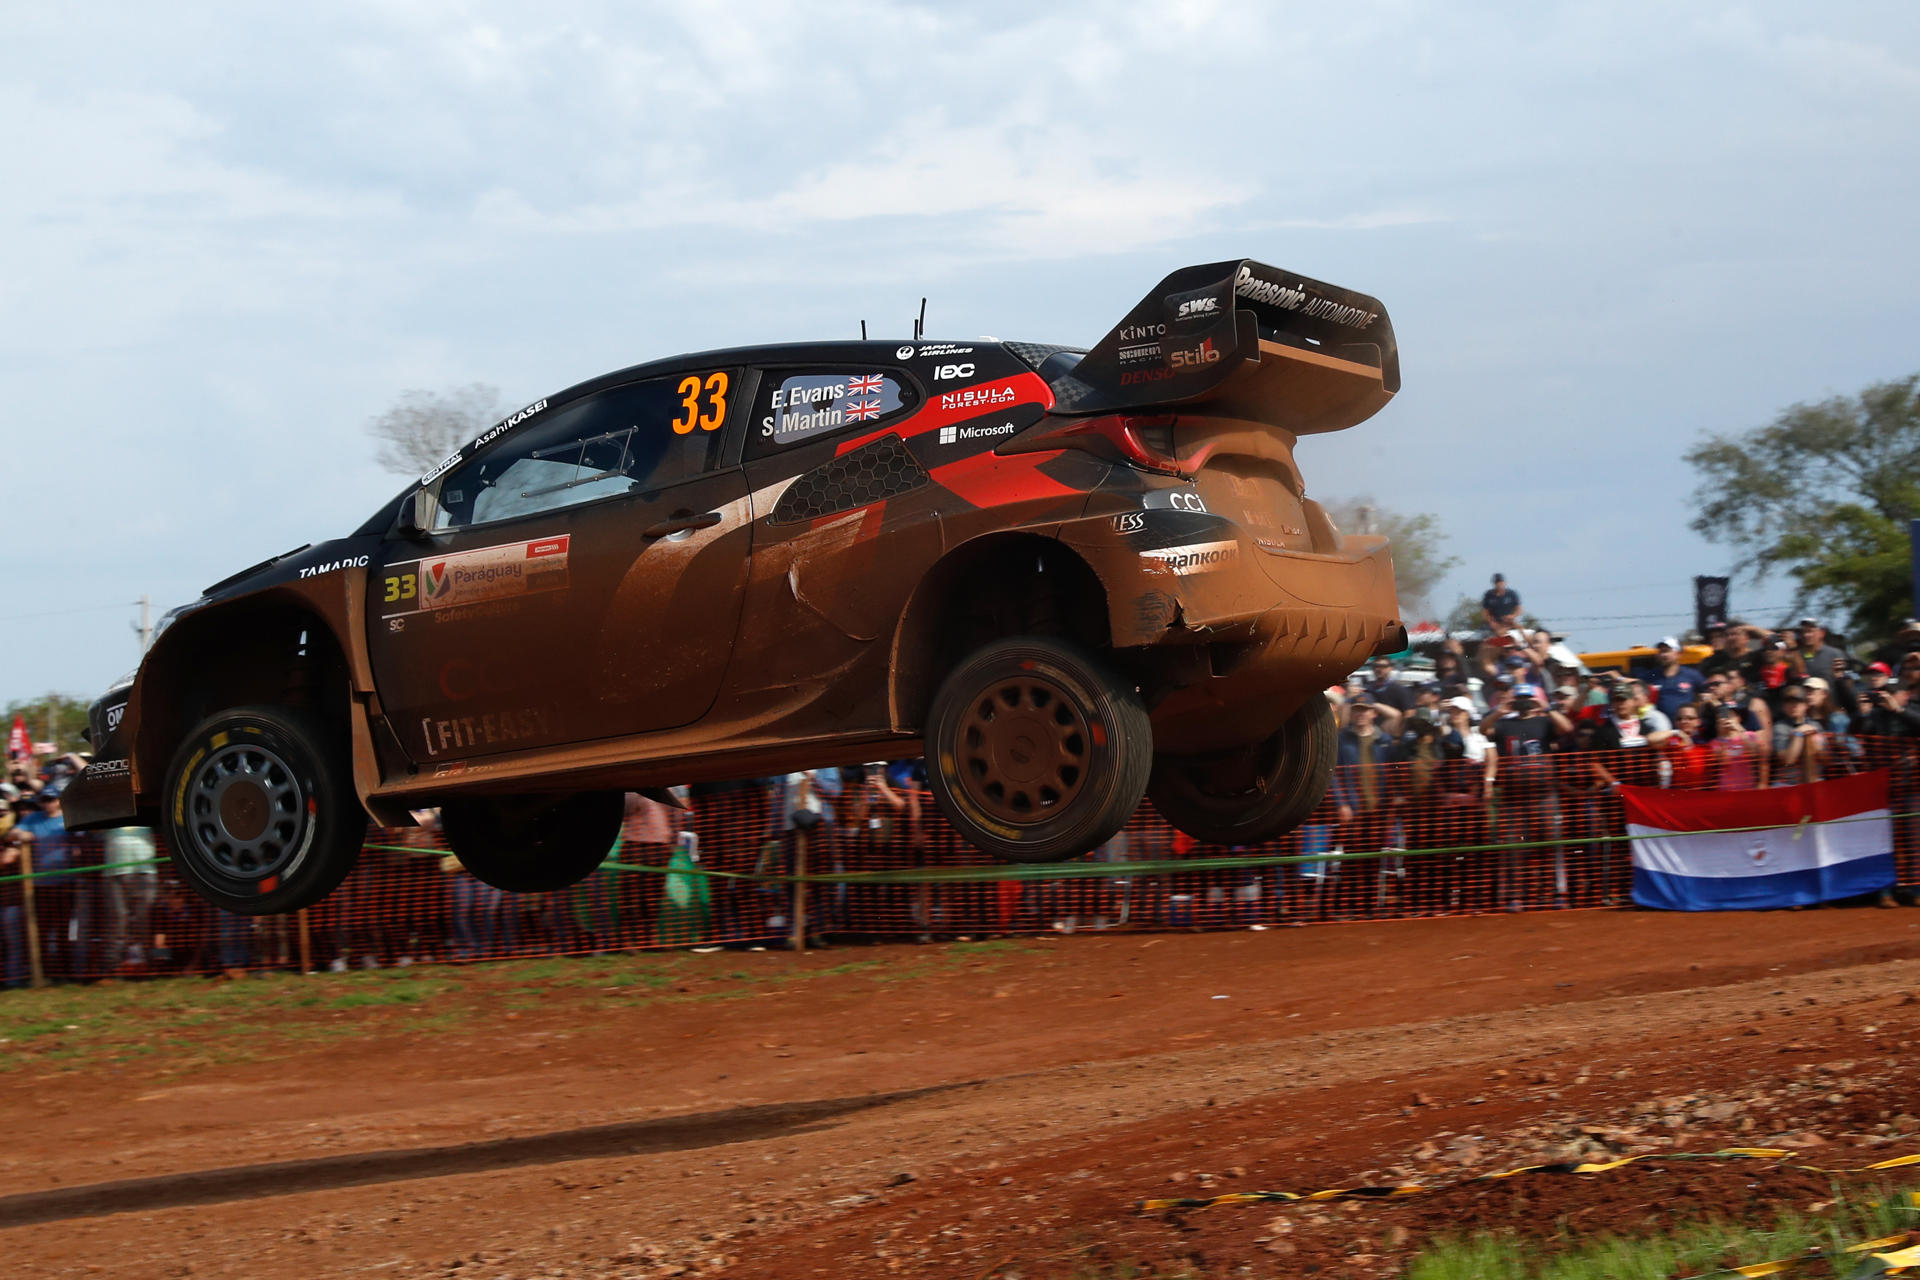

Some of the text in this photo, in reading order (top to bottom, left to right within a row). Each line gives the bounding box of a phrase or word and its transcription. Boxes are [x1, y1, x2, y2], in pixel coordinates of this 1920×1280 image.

[1178, 297, 1217, 317] SWS
[1236, 266, 1378, 330] Panasonic AUTOMOTIVE
[919, 344, 956, 352] JAPAN
[920, 347, 974, 357] AIRLINES
[1171, 341, 1220, 368] Stilo
[1120, 368, 1176, 386] DENSO
[672, 371, 729, 435] 33
[771, 384, 845, 410] E.Evans
[942, 387, 1015, 405] NISULA
[762, 407, 842, 437] S.Martin
[960, 422, 1015, 439] Microsoft
[1111, 512, 1145, 532] LESS
[299, 555, 370, 579] TAMADIC
[454, 562, 522, 585] Paraguay
[384, 572, 417, 603] 33
